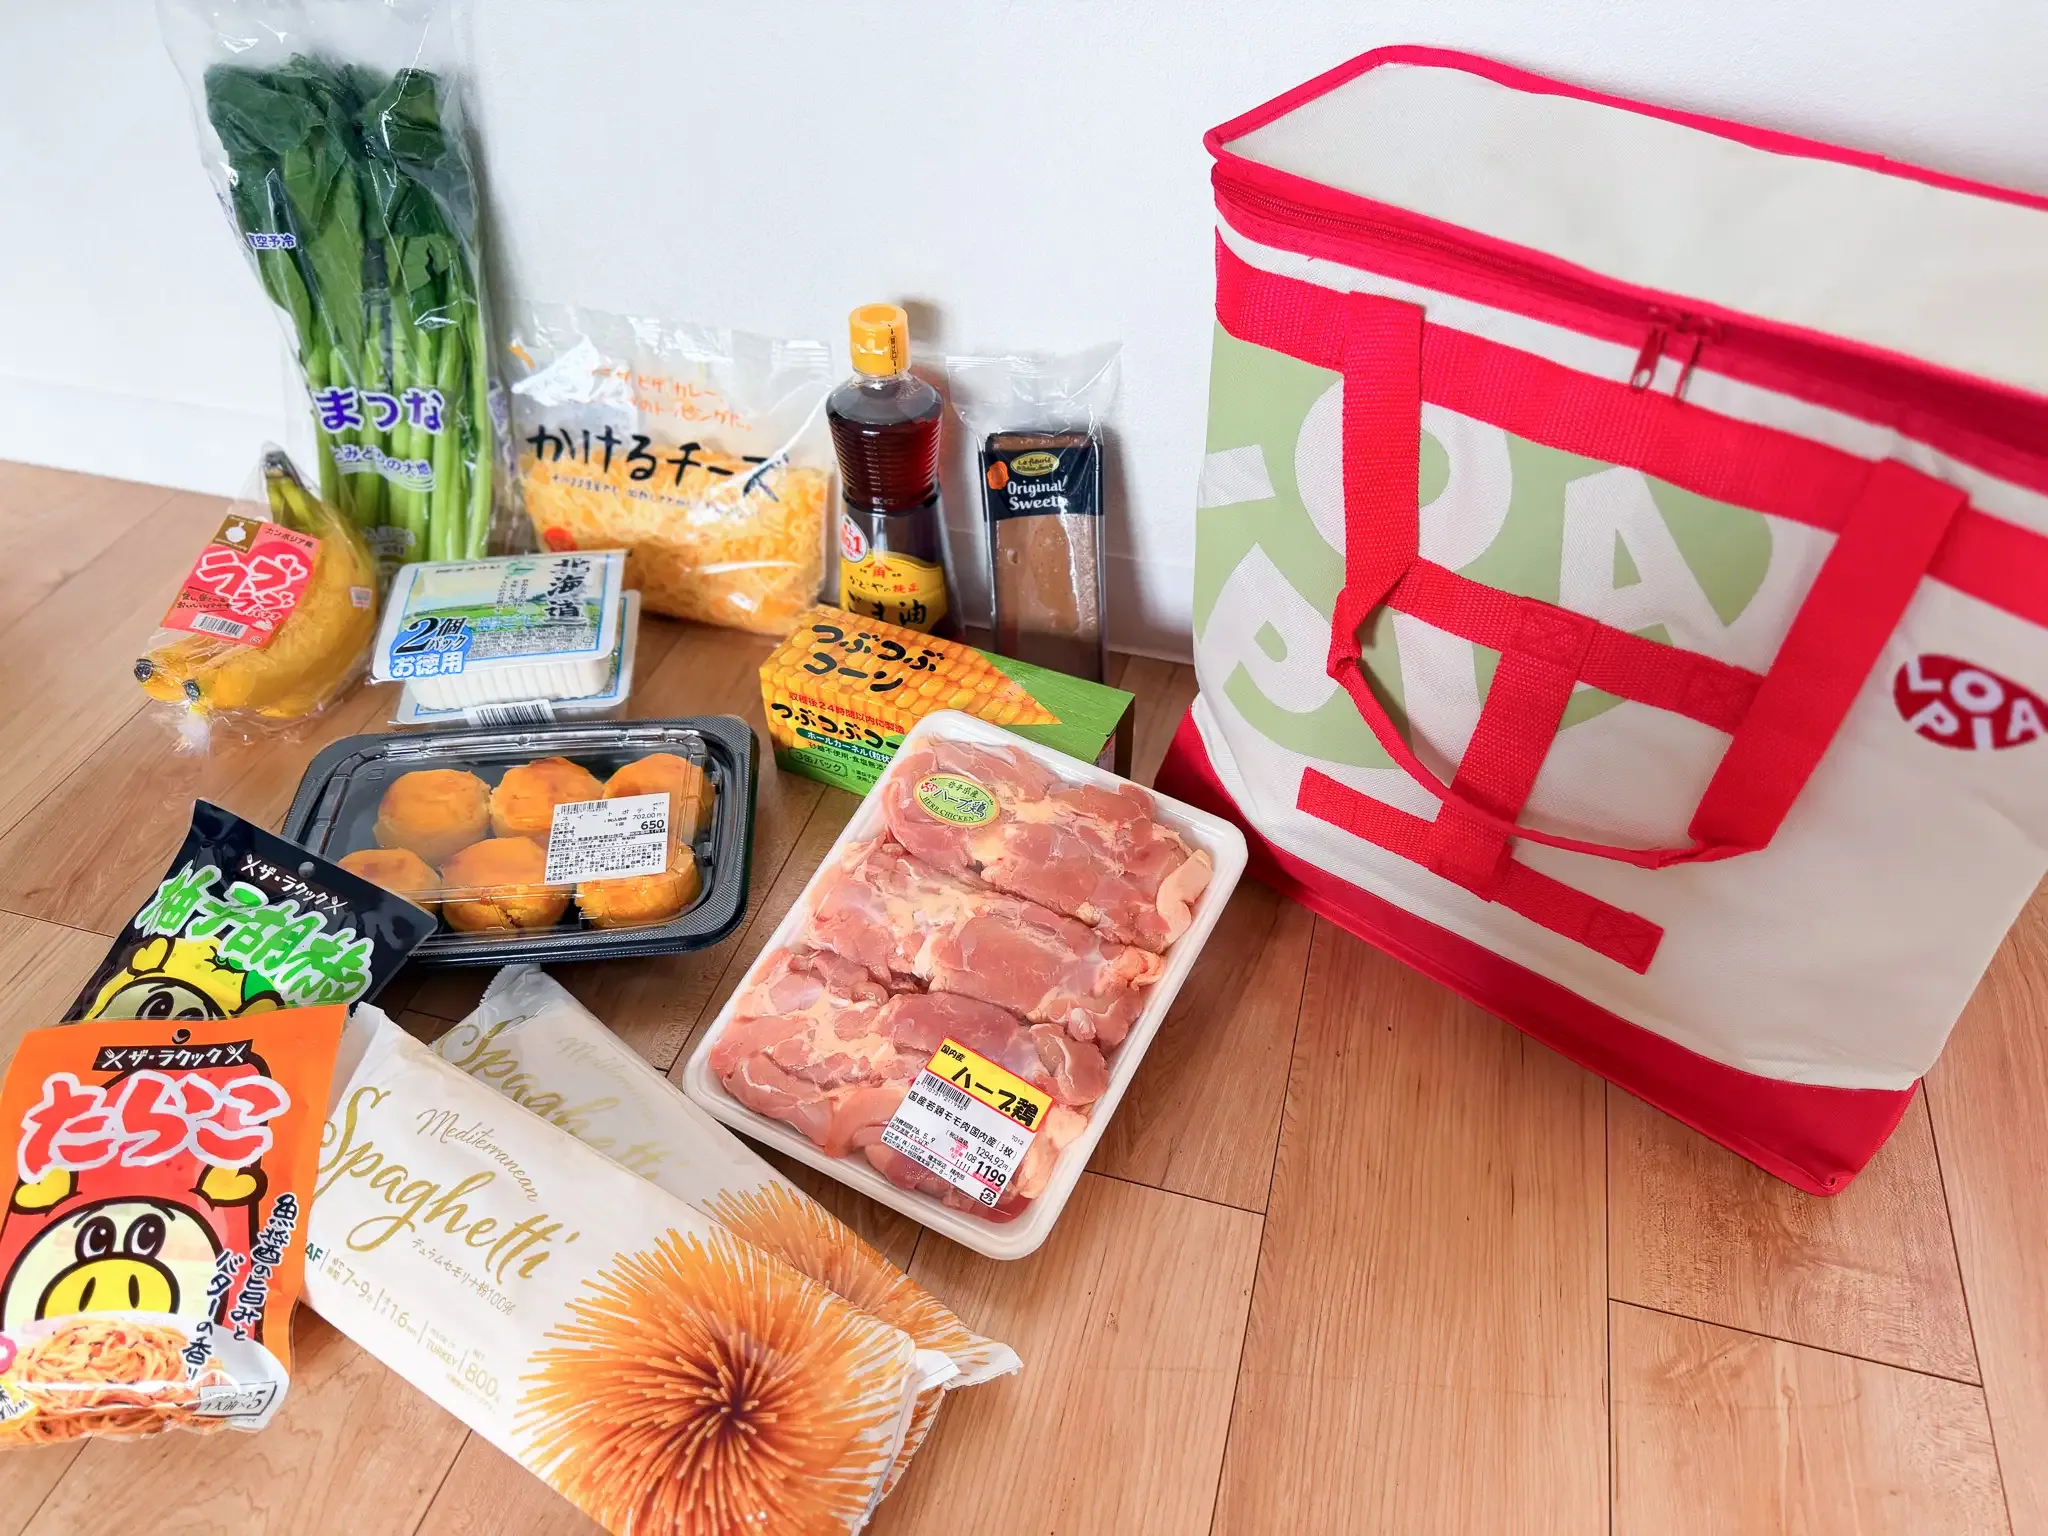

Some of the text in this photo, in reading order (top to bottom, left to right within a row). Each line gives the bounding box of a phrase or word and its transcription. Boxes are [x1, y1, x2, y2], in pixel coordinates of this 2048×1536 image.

[526, 424, 789, 503] かけるチーズ
[1007, 479, 1064, 498] Original
[541, 557, 592, 627] 北海道
[390, 651, 464, 678] お徳用
[811, 623, 946, 672] つぶつぶ
[803, 651, 904, 693] コーン
[1907, 655, 2044, 753] LOPIA
[922, 796, 976, 822] HERB CHICKEN
[932, 788, 988, 819] ハーブ鶏
[640, 819, 666, 831] 650
[256, 861, 330, 907] ザ・ラクック
[129, 1047, 224, 1067] ザ・ラクック
[940, 1043, 967, 1063] 国内産
[951, 1065, 1040, 1128] ハーブ鶏
[17, 1070, 291, 1184] たらこ
[416, 1108, 541, 1203] Mediterranean
[964, 1151, 977, 1164] 108
[975, 1160, 1007, 1187] 1199
[313, 1085, 581, 1285] Spaghetti
